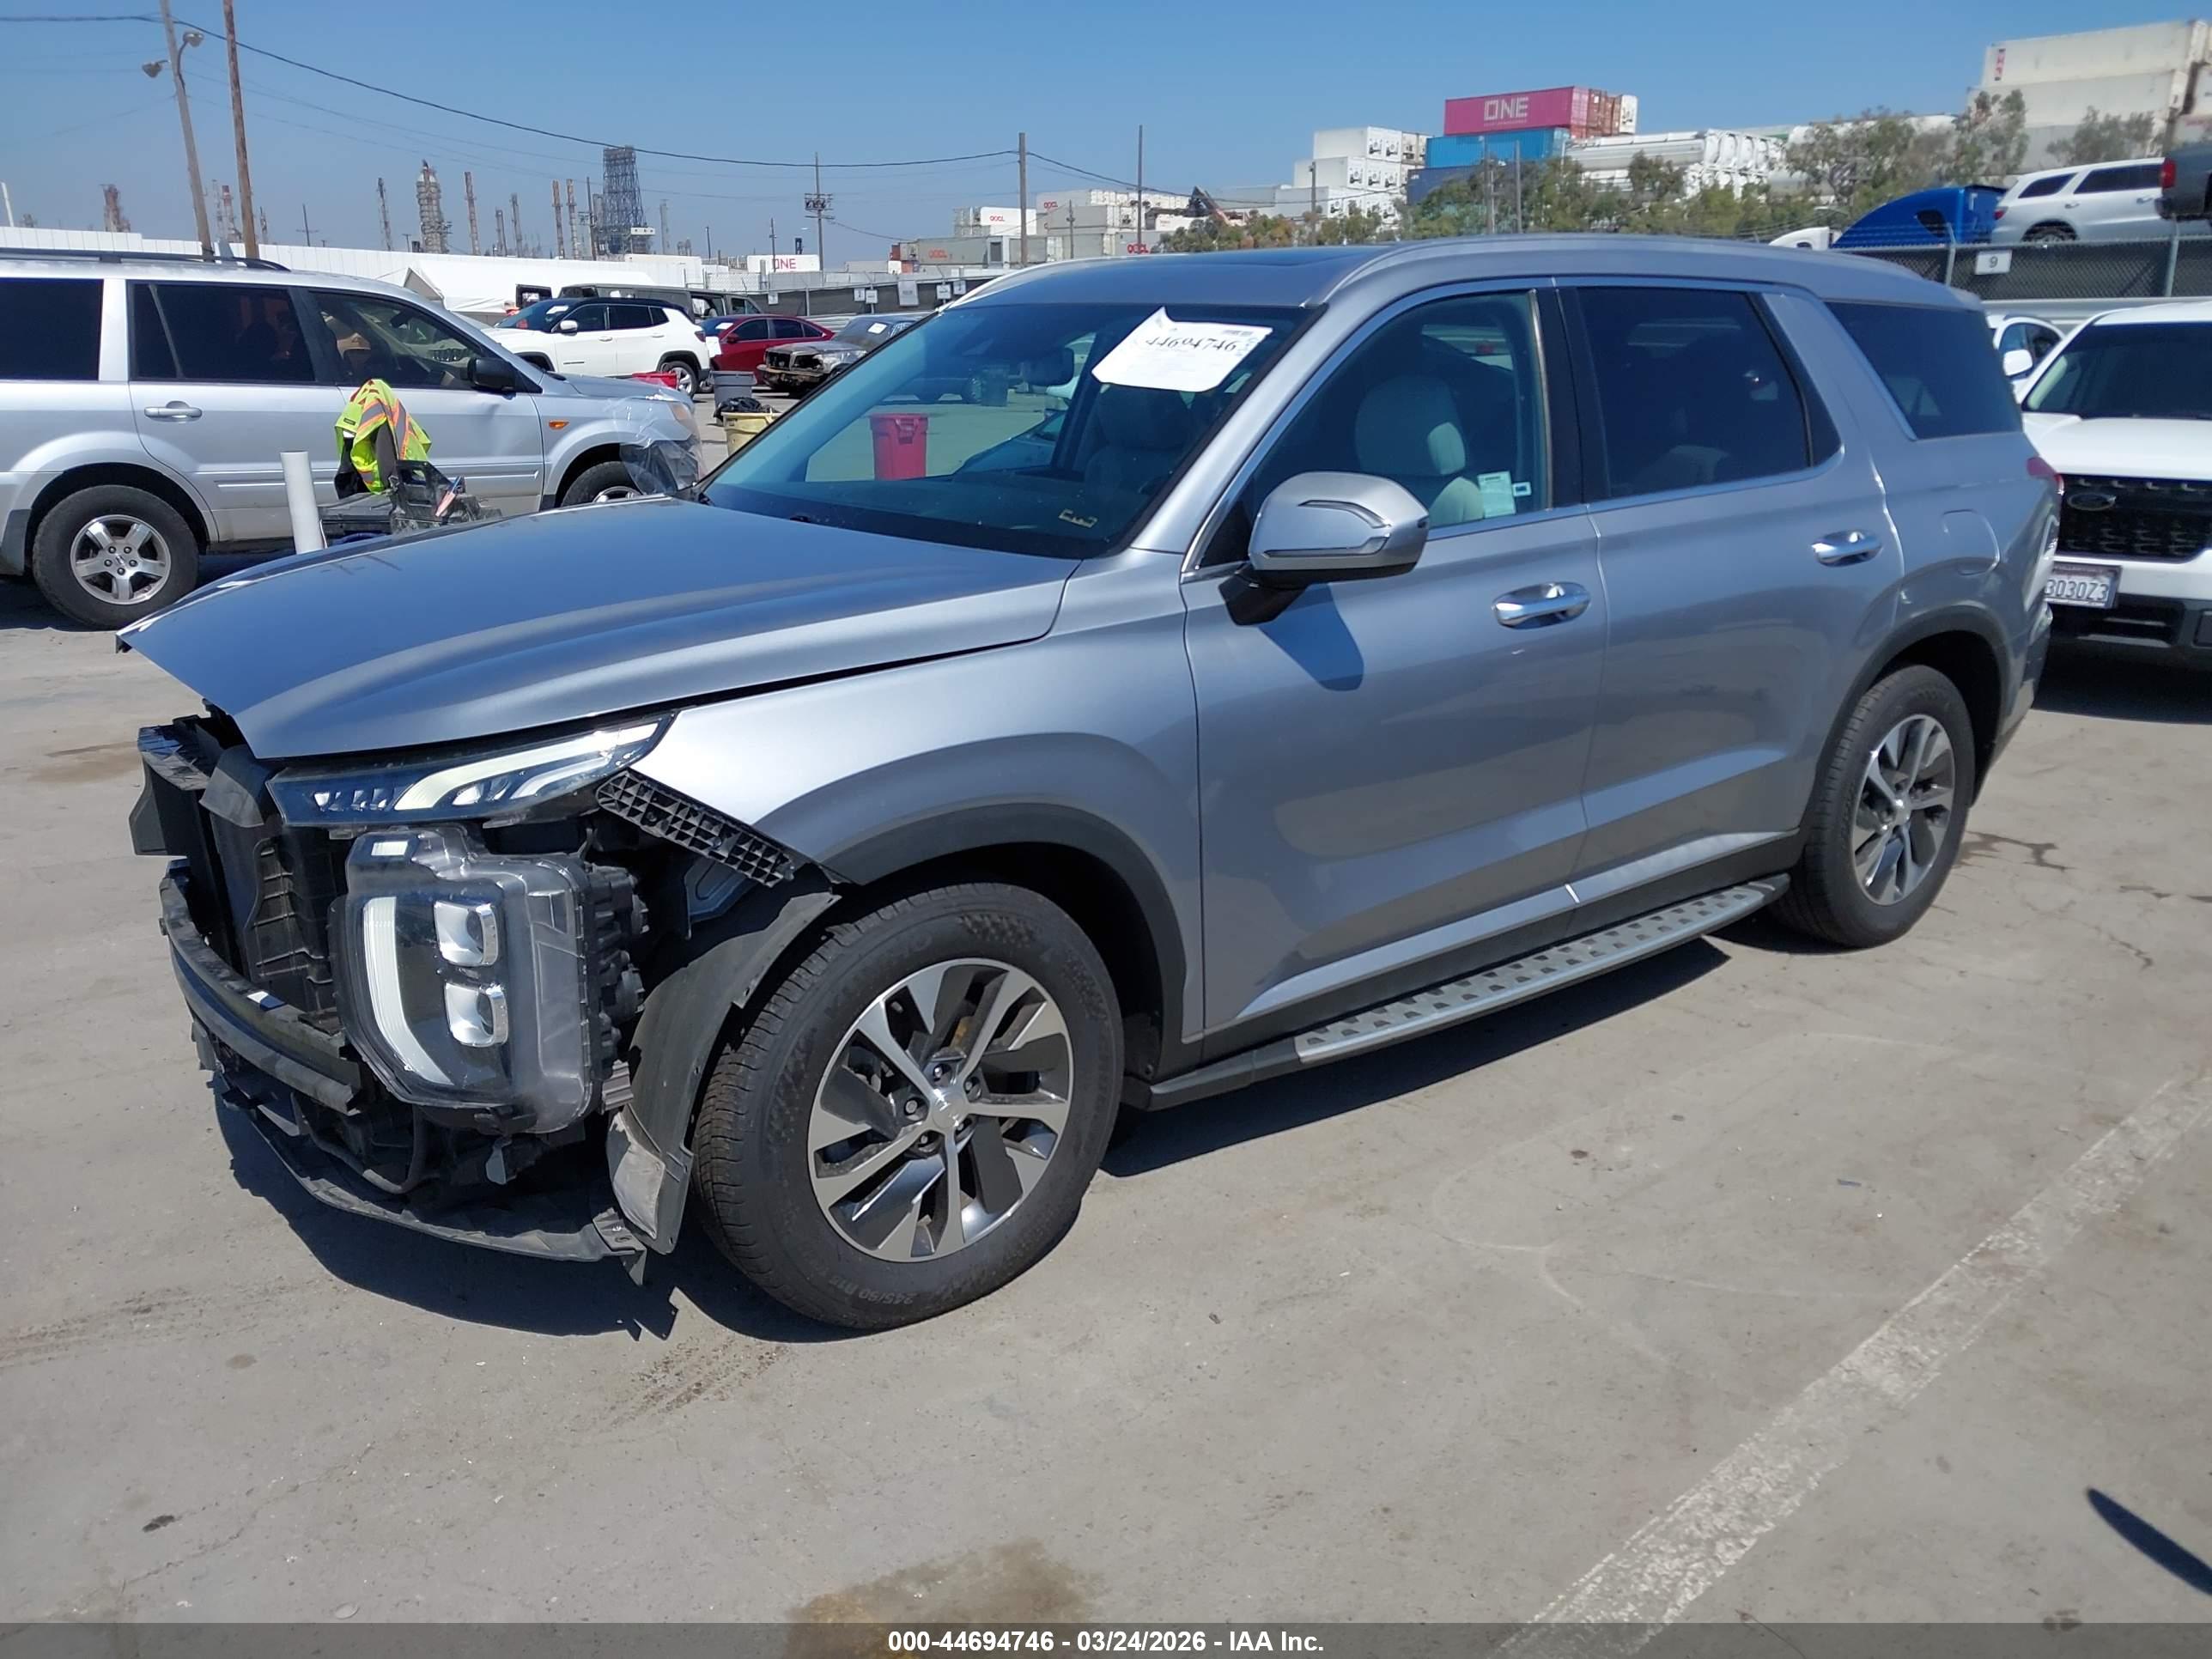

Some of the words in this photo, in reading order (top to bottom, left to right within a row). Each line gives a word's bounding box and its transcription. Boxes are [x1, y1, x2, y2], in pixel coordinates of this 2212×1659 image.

[1484, 97, 1528, 120] ONE
[772, 258, 797, 270] ONE
[1989, 256, 1999, 268] 9
[2045, 579, 2109, 601] 3030Z3
